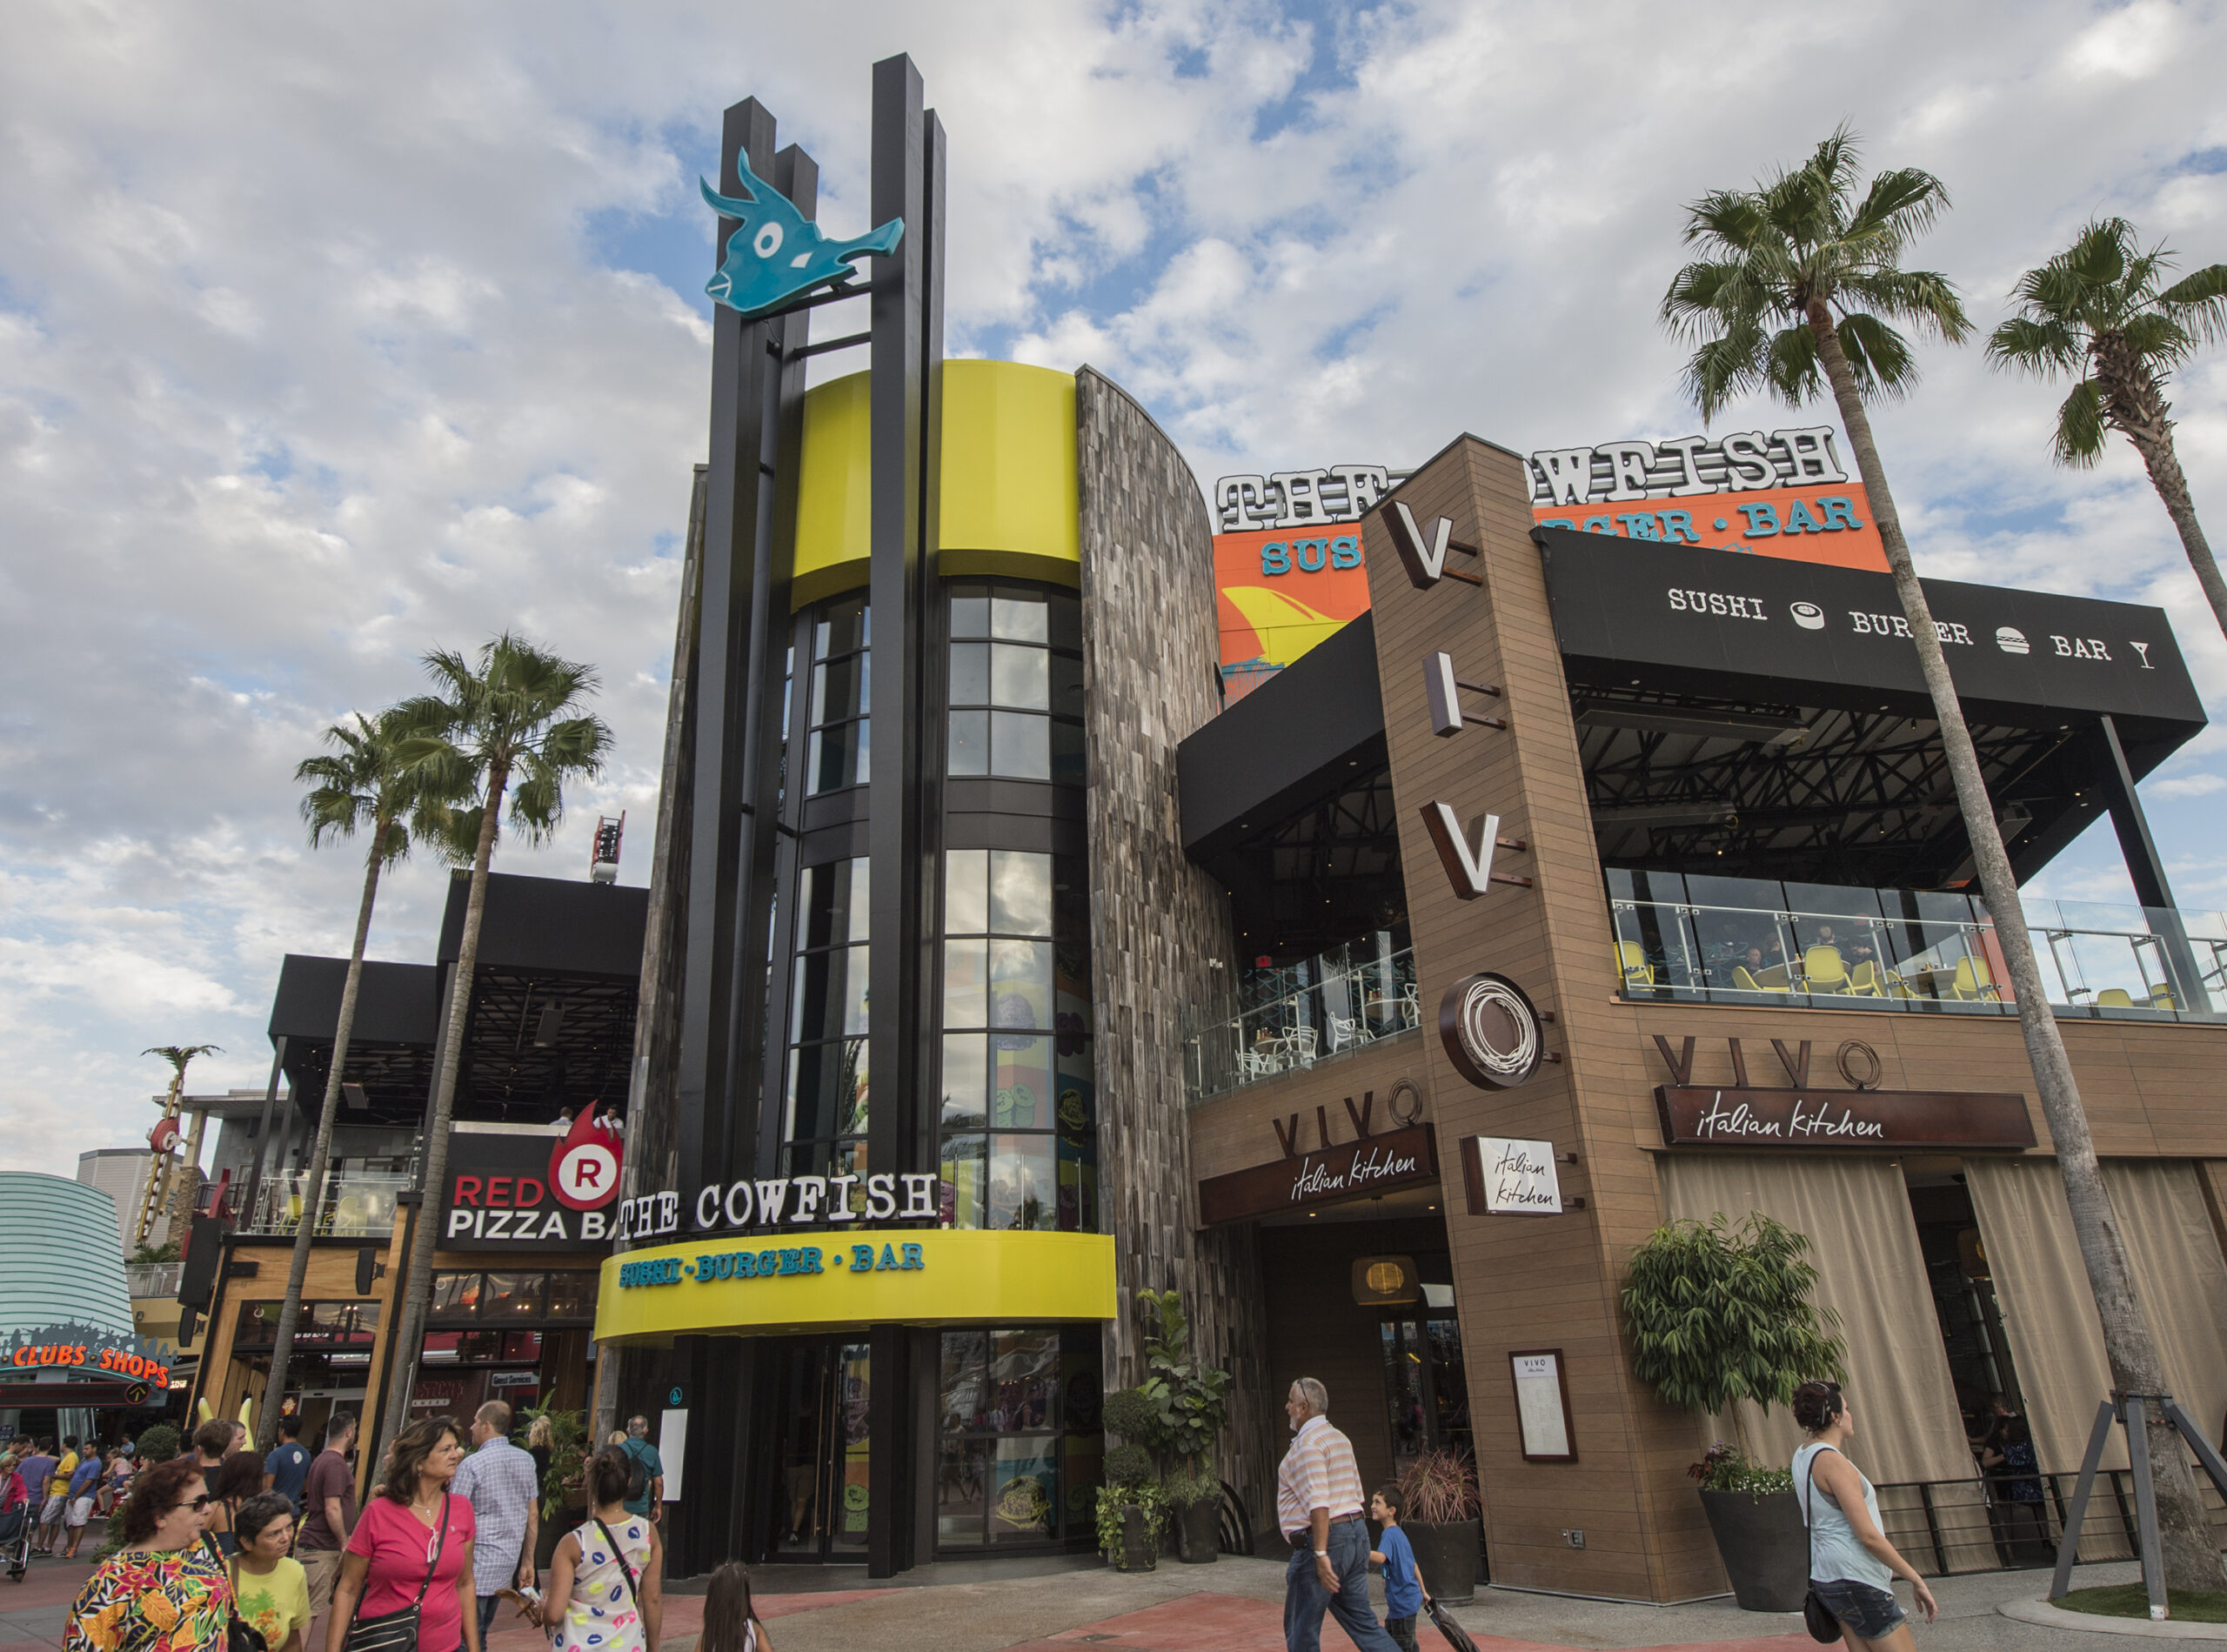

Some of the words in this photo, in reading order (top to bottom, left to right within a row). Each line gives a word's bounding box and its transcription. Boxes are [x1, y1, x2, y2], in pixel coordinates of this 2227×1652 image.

[1523, 425, 1849, 508] WFISH
[1261, 534, 1366, 576] SUS
[1737, 496, 1864, 538] BAR
[1668, 587, 1769, 621] SUSHI
[1849, 611, 1974, 646] BURER
[2050, 635, 2112, 661] BAR
[1653, 1034, 1883, 1092] VIVO
[1272, 1078, 1423, 1159] VIVO
[1697, 1090, 1782, 1140] italian
[1789, 1100, 1884, 1139] kitchen
[1291, 1157, 1345, 1201] italian
[1348, 1147, 1417, 1188] kitchen
[1495, 1143, 1546, 1176] italian
[452, 1175, 545, 1207] RED
[619, 1190, 679, 1241] THE
[696, 1173, 938, 1229] COWFISH
[1495, 1178, 1554, 1206] kitchen
[446, 1209, 568, 1241] PIZZA
[619, 1256, 685, 1289] SUSHI
[693, 1245, 825, 1282] BURGER
[849, 1241, 926, 1272] BAR
[14, 1345, 87, 1367] CLUBS
[98, 1348, 170, 1388] SHOPS
